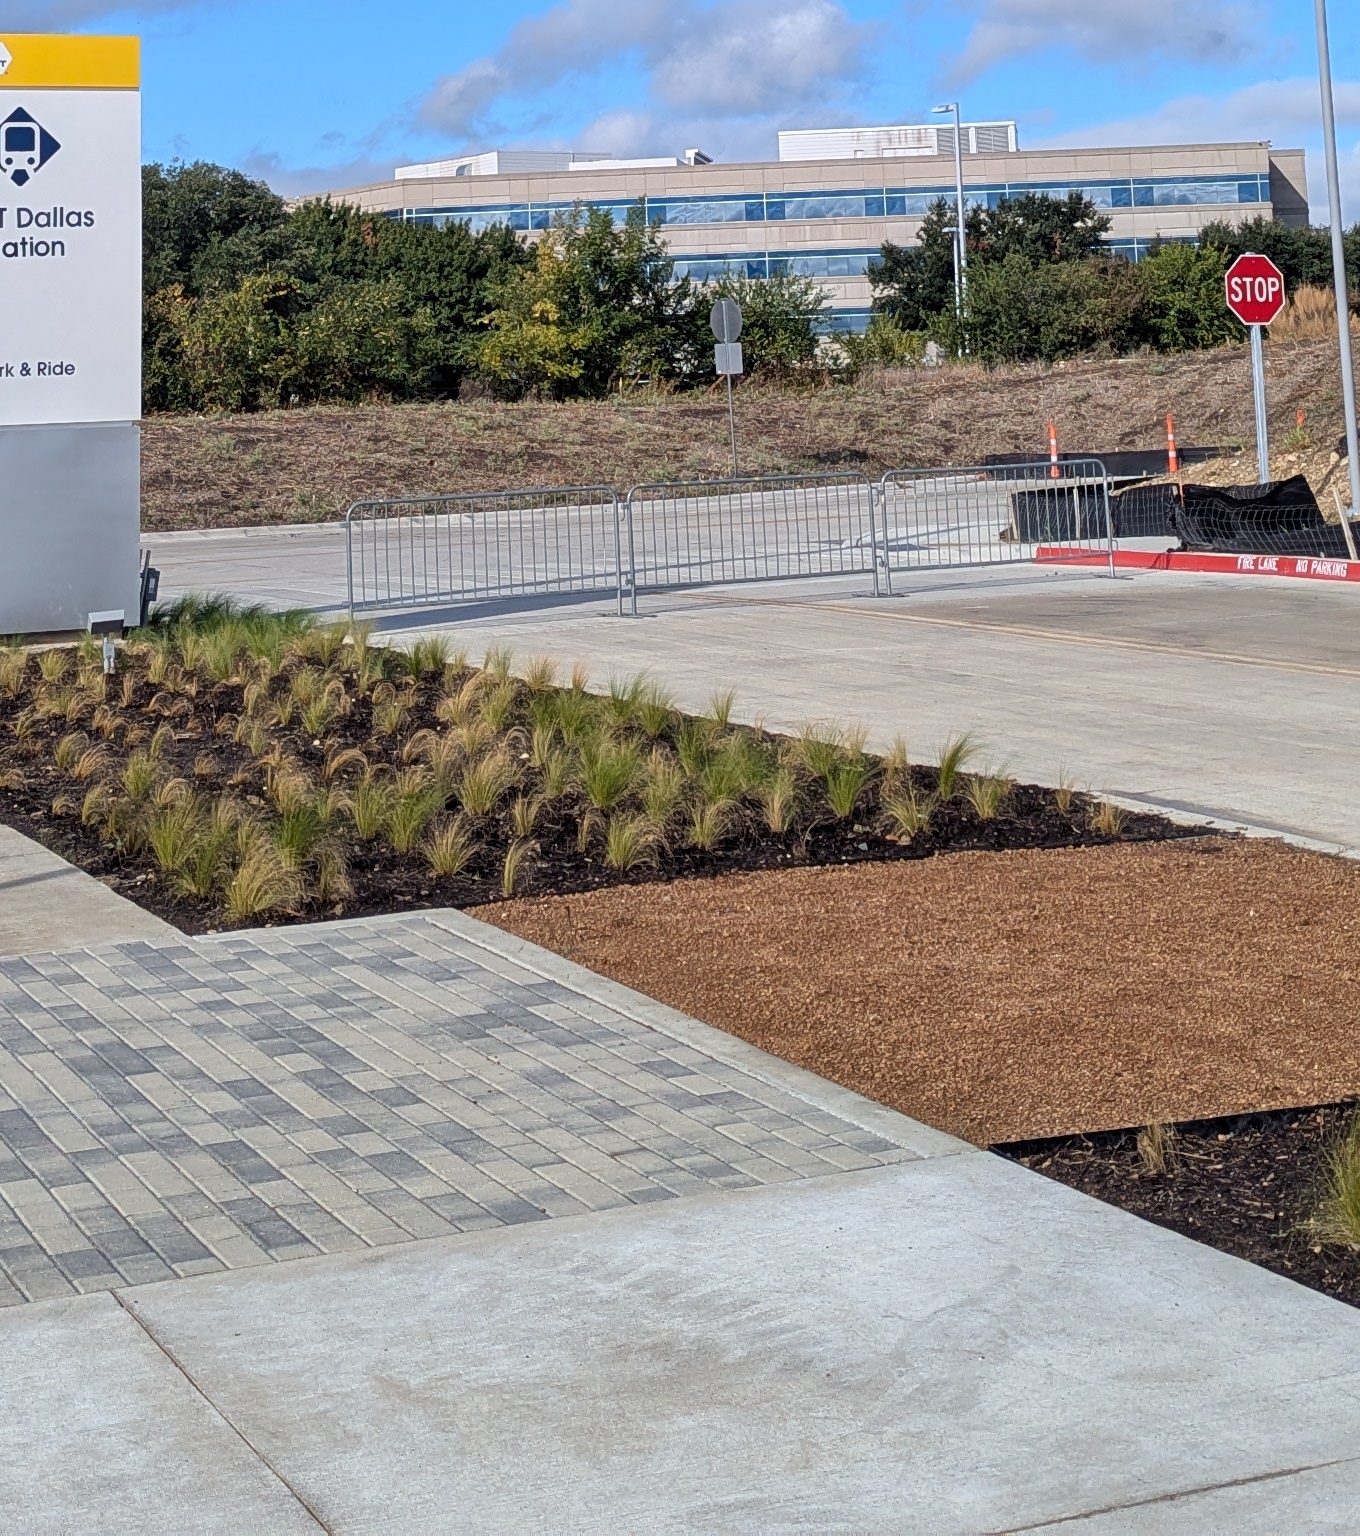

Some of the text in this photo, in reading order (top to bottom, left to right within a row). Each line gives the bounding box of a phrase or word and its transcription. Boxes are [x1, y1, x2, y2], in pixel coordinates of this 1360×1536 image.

[16, 206, 95, 228] Dallas
[1231, 276, 1280, 303] STOP
[20, 362, 32, 377] &
[37, 361, 76, 376] Ride
[1237, 556, 1348, 578] FIRE LANE NO PARKING
